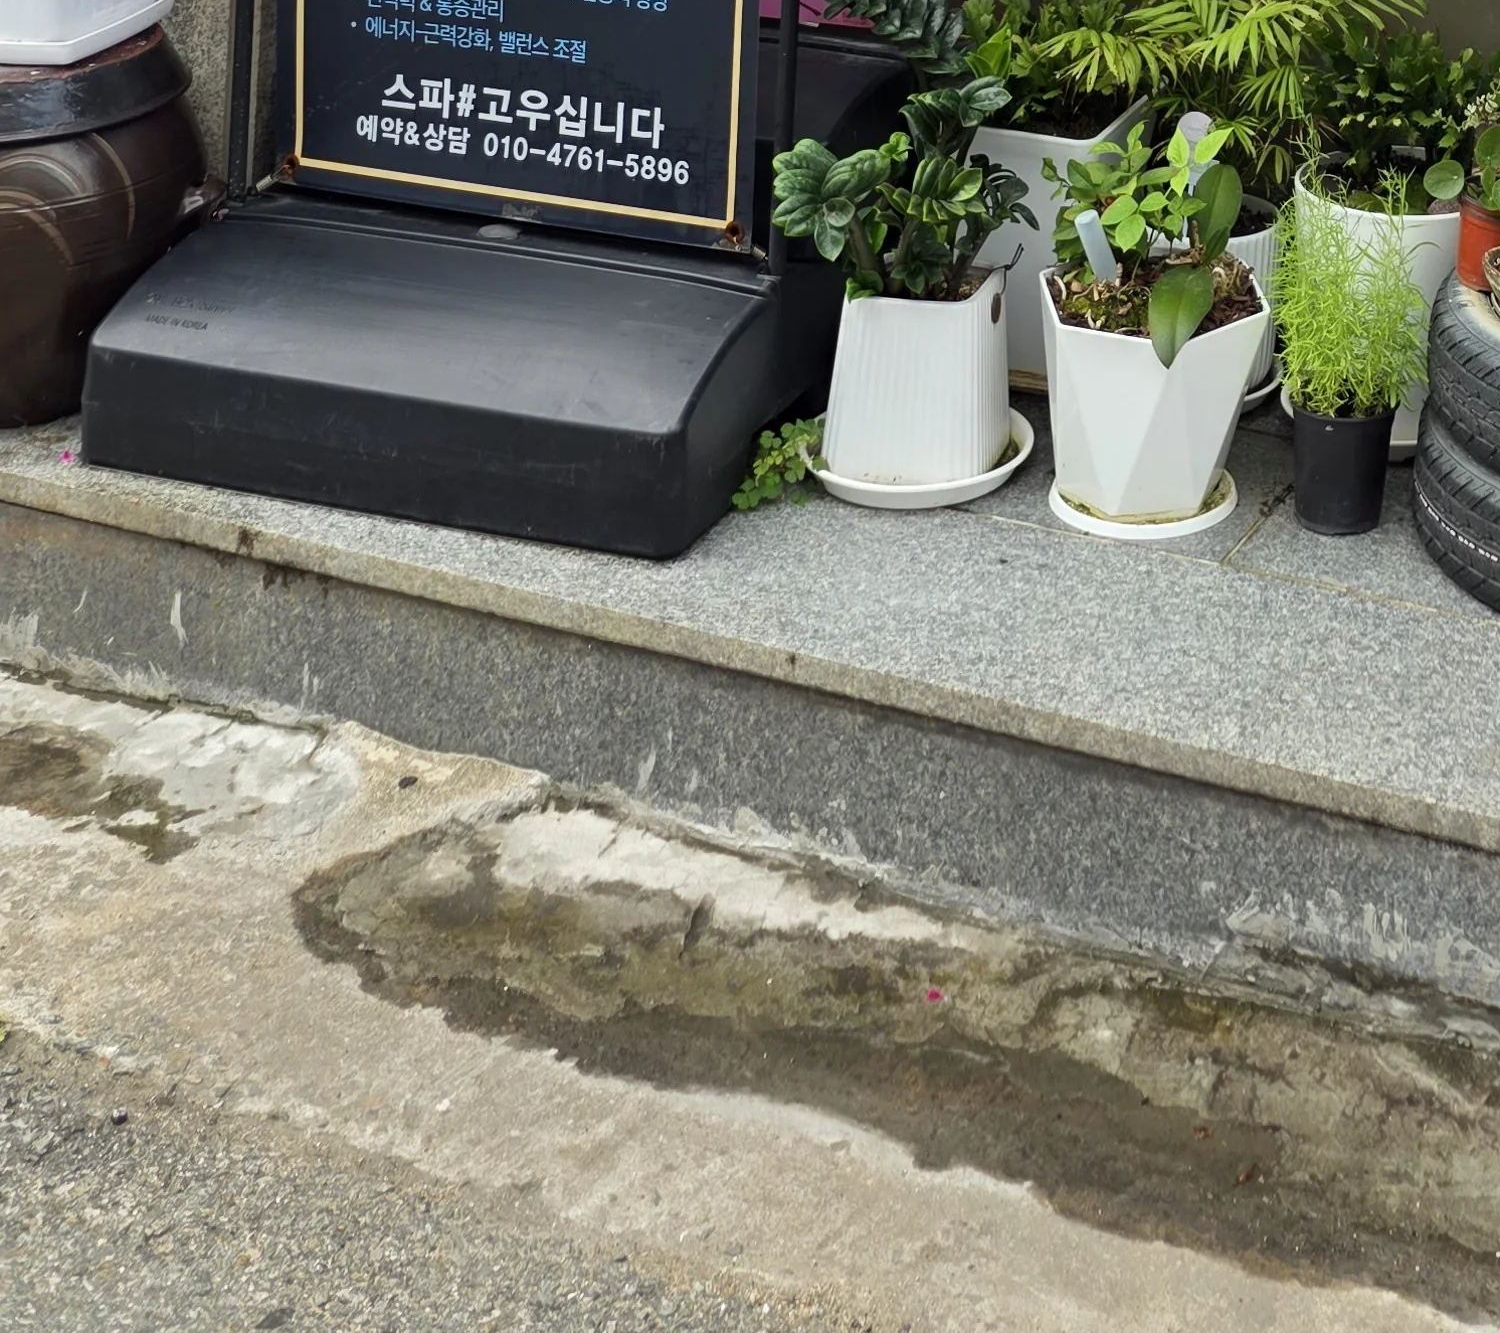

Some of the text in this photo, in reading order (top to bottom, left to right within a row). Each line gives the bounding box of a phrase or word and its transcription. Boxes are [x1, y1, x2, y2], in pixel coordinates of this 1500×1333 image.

[498, 29, 549, 58] 밸런스
[553, 37, 587, 64] 조절
[381, 73, 665, 149] 스파#고우십니다
[356, 113, 690, 185] 예약&상담 010-4761-5896
